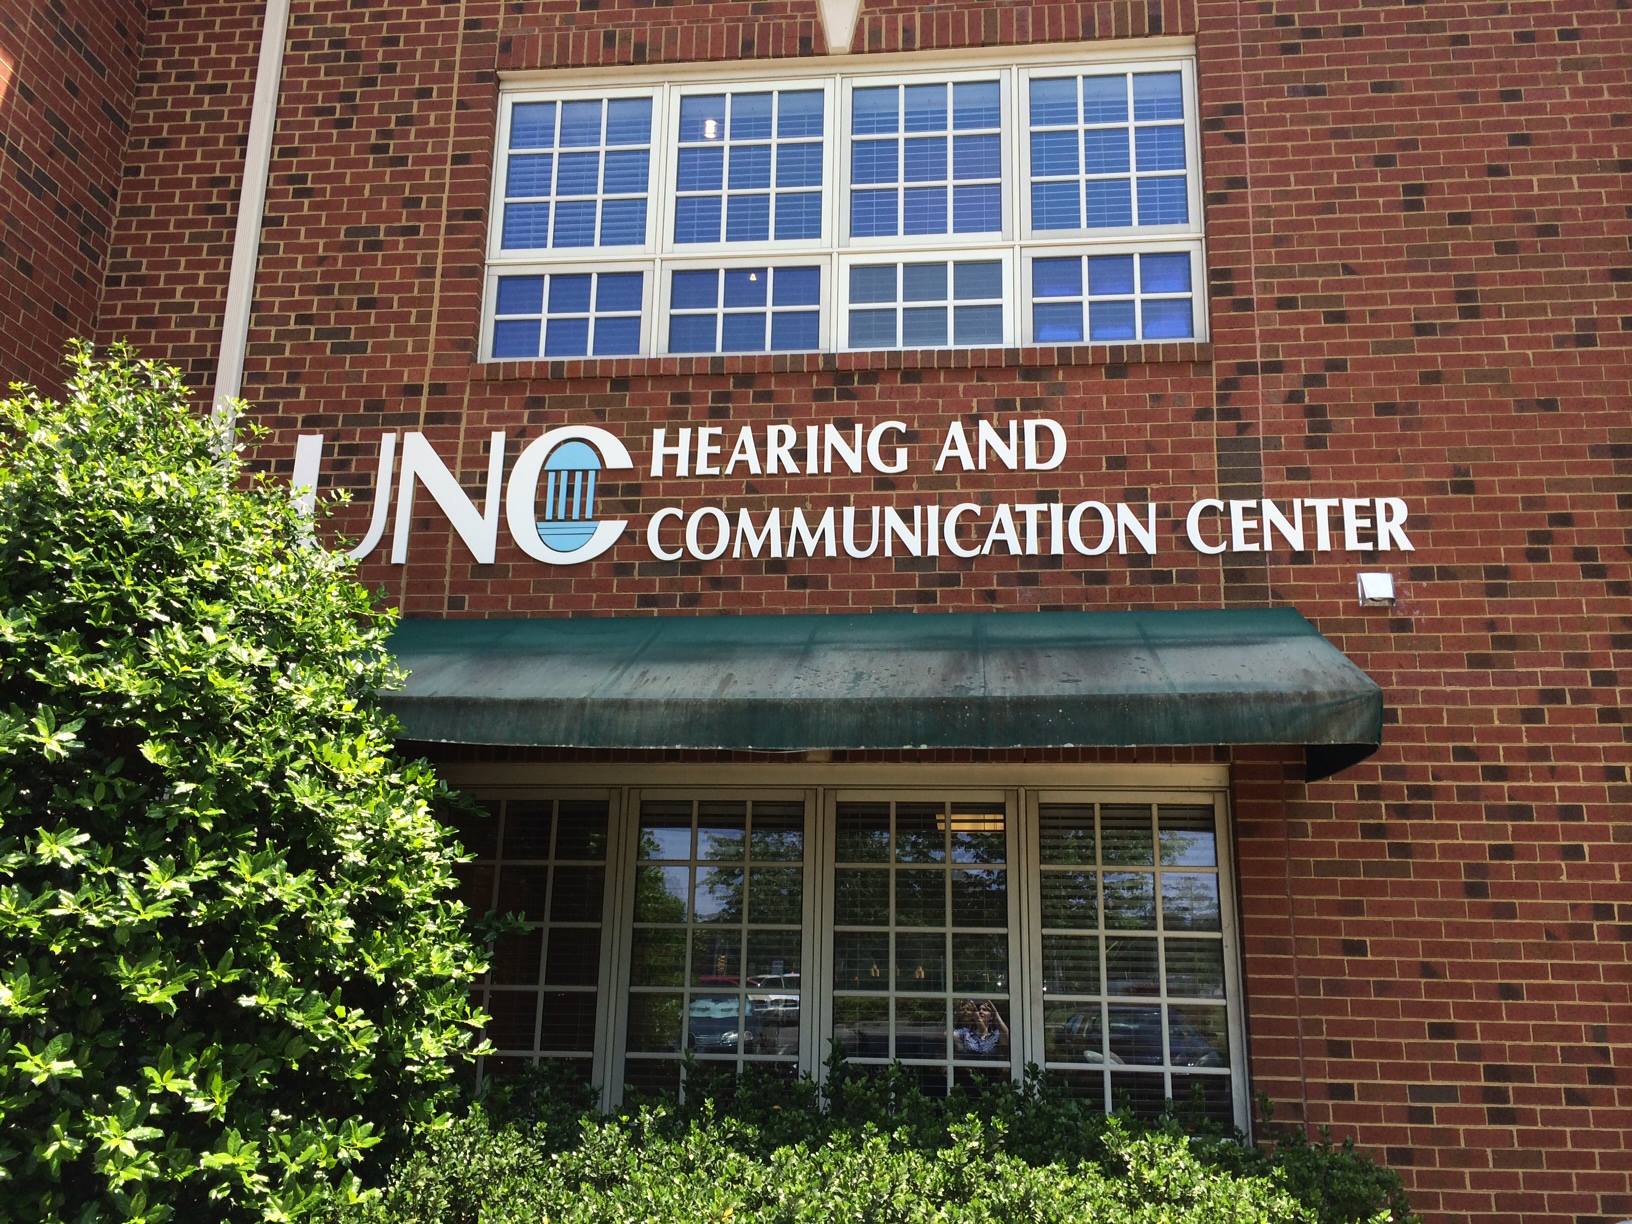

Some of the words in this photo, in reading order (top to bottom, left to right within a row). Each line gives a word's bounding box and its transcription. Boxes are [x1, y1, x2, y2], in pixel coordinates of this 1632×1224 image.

[650, 420, 908, 478] HEARING
[934, 418, 1067, 472] AND
[288, 425, 634, 566] UNC
[646, 500, 1157, 562] COMMUNICATION
[1186, 496, 1415, 555] CENTER
